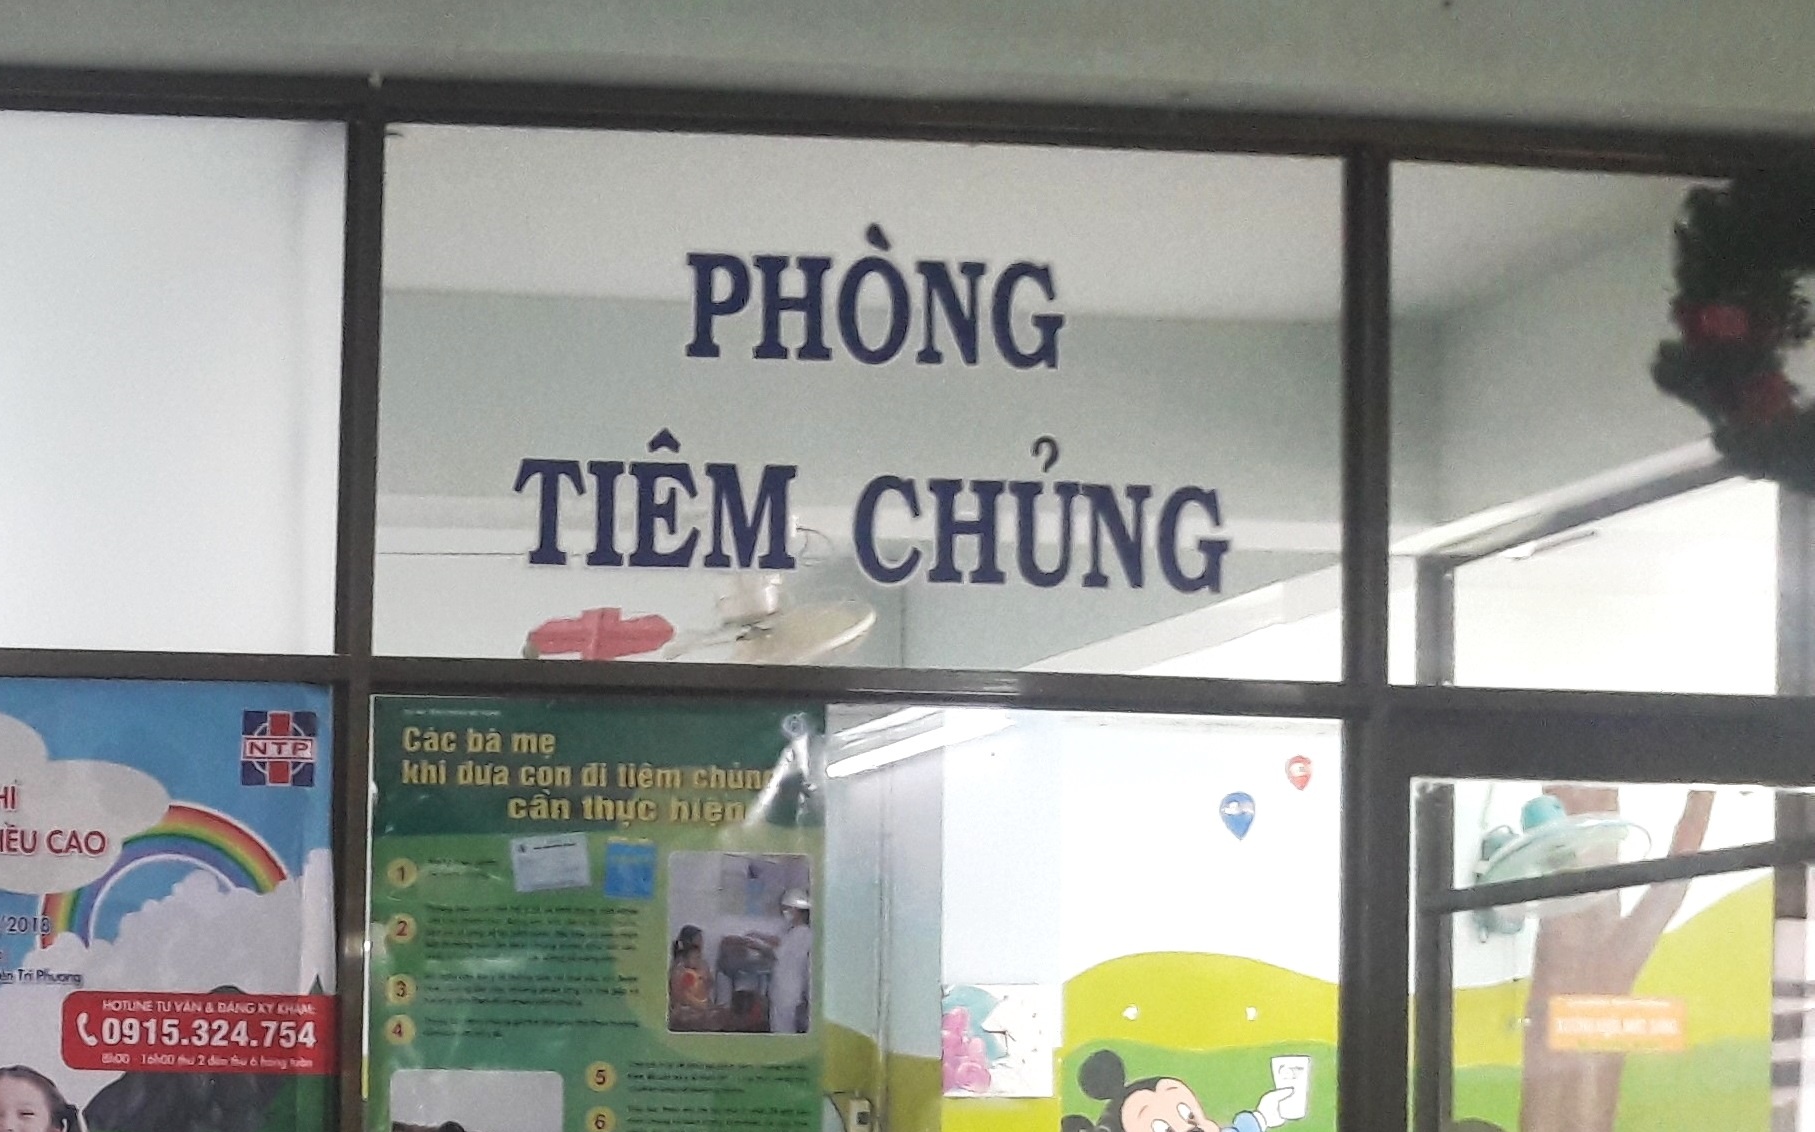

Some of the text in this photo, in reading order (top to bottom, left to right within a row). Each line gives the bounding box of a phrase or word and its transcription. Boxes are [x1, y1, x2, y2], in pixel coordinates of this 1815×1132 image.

[685, 223, 1065, 369] PHÒNG
[514, 428, 1229, 592] TIÊM CHỦNG
[248, 741, 309, 756] NTP
[512, 731, 556, 759] mẹ
[402, 759, 447, 785] khi
[520, 765, 572, 787] con
[582, 762, 607, 787] đi
[618, 762, 681, 788] tiêm
[46, 829, 107, 855] CAO
[396, 866, 407, 882] 1
[396, 921, 408, 937] 2
[396, 981, 408, 997] 3
[101, 1017, 317, 1048] 0915.324.754
[391, 1023, 404, 1038] 4
[594, 1069, 605, 1085] 5
[594, 1113, 605, 1130] 6
